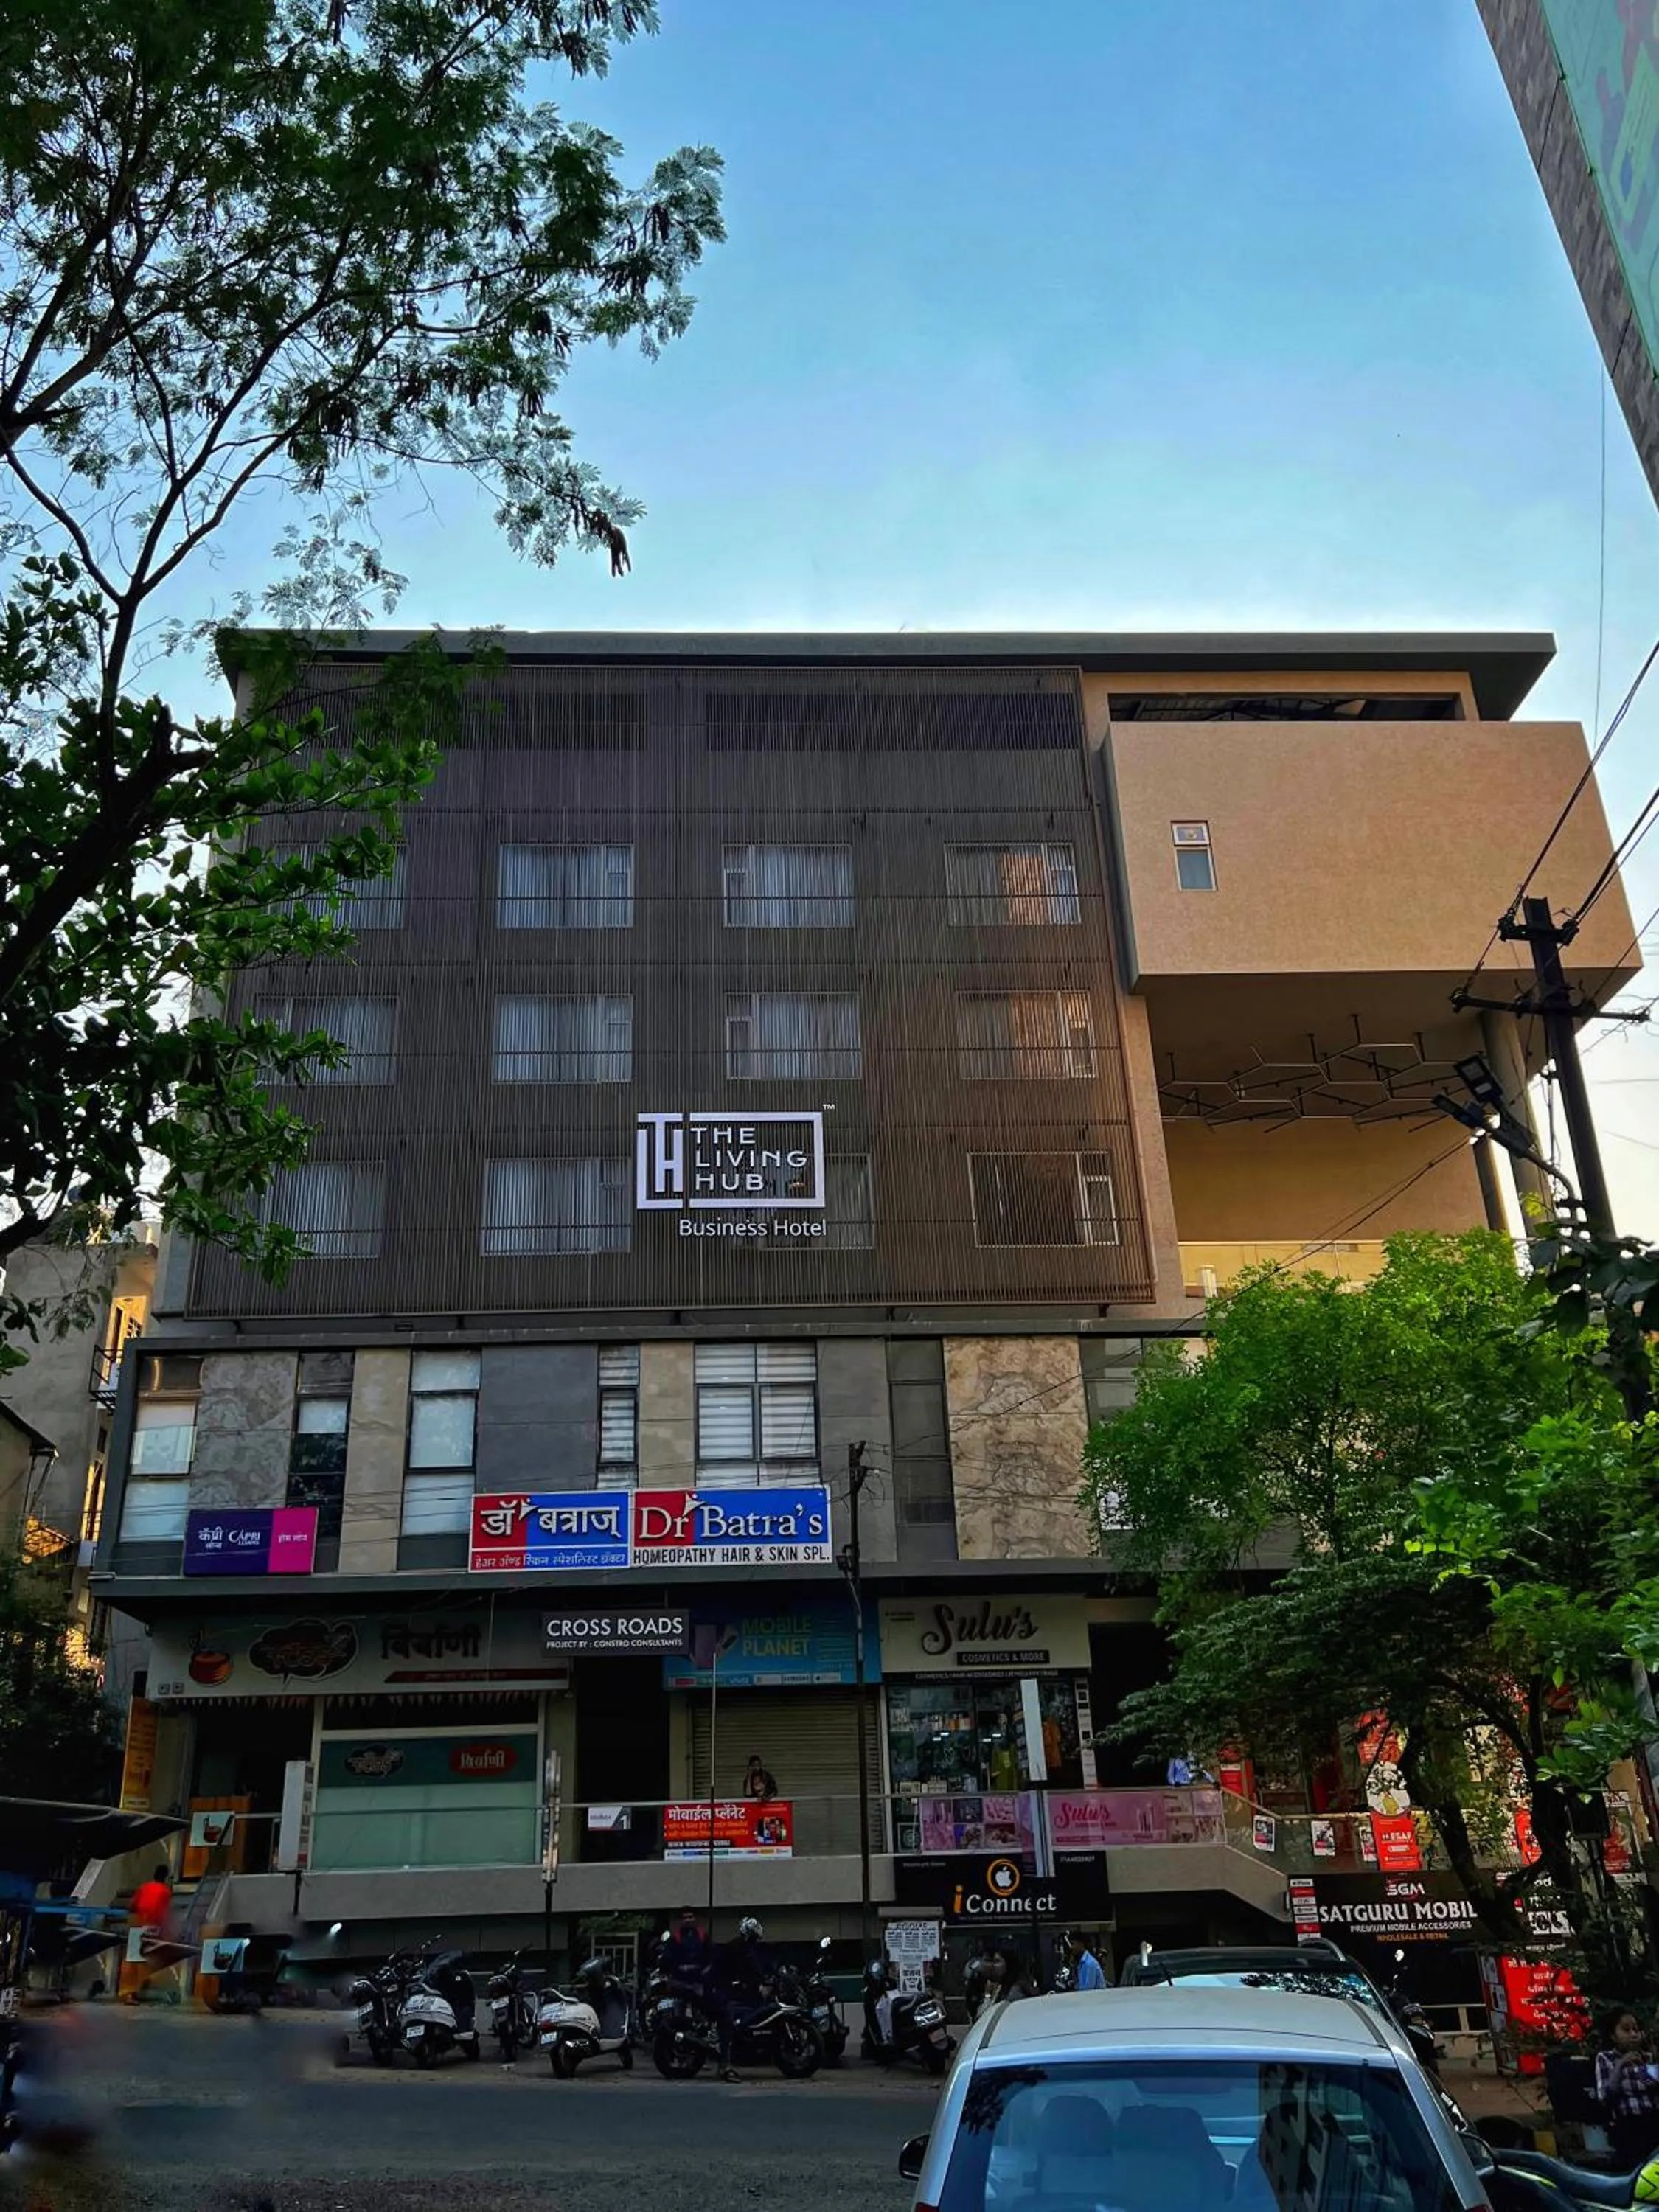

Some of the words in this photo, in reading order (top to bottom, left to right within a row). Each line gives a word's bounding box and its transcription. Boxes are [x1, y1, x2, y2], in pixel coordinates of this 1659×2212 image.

[690, 1127, 756, 1144] THE
[695, 1150, 808, 1167] LIVING
[695, 1173, 765, 1191] HUB
[679, 1218, 768, 1237] Business
[774, 1218, 827, 1237] Hotel
[639, 1506, 689, 1539] Dr
[700, 1503, 824, 1538] Batra's
[633, 1548, 715, 1564] HOMEOPATHY
[722, 1548, 751, 1562] HAIR
[755, 1548, 764, 1561] &
[769, 1546, 799, 1562] SKIN
[803, 1545, 830, 1561] SPL.
[547, 1618, 611, 1636] CROSS
[617, 1618, 683, 1635] ROADS
[742, 1616, 812, 1635] MOBILE
[922, 1601, 1039, 1655] Sulu's
[742, 1638, 809, 1657] PLANET
[962, 1652, 1009, 1663] COSMETICS
[1020, 1652, 1046, 1662] MORE
[1319, 1902, 1409, 1923] SATGURU
[1413, 1900, 1478, 1919] MOBIL
[1419, 1921, 1472, 1930] ACCESSORIES
